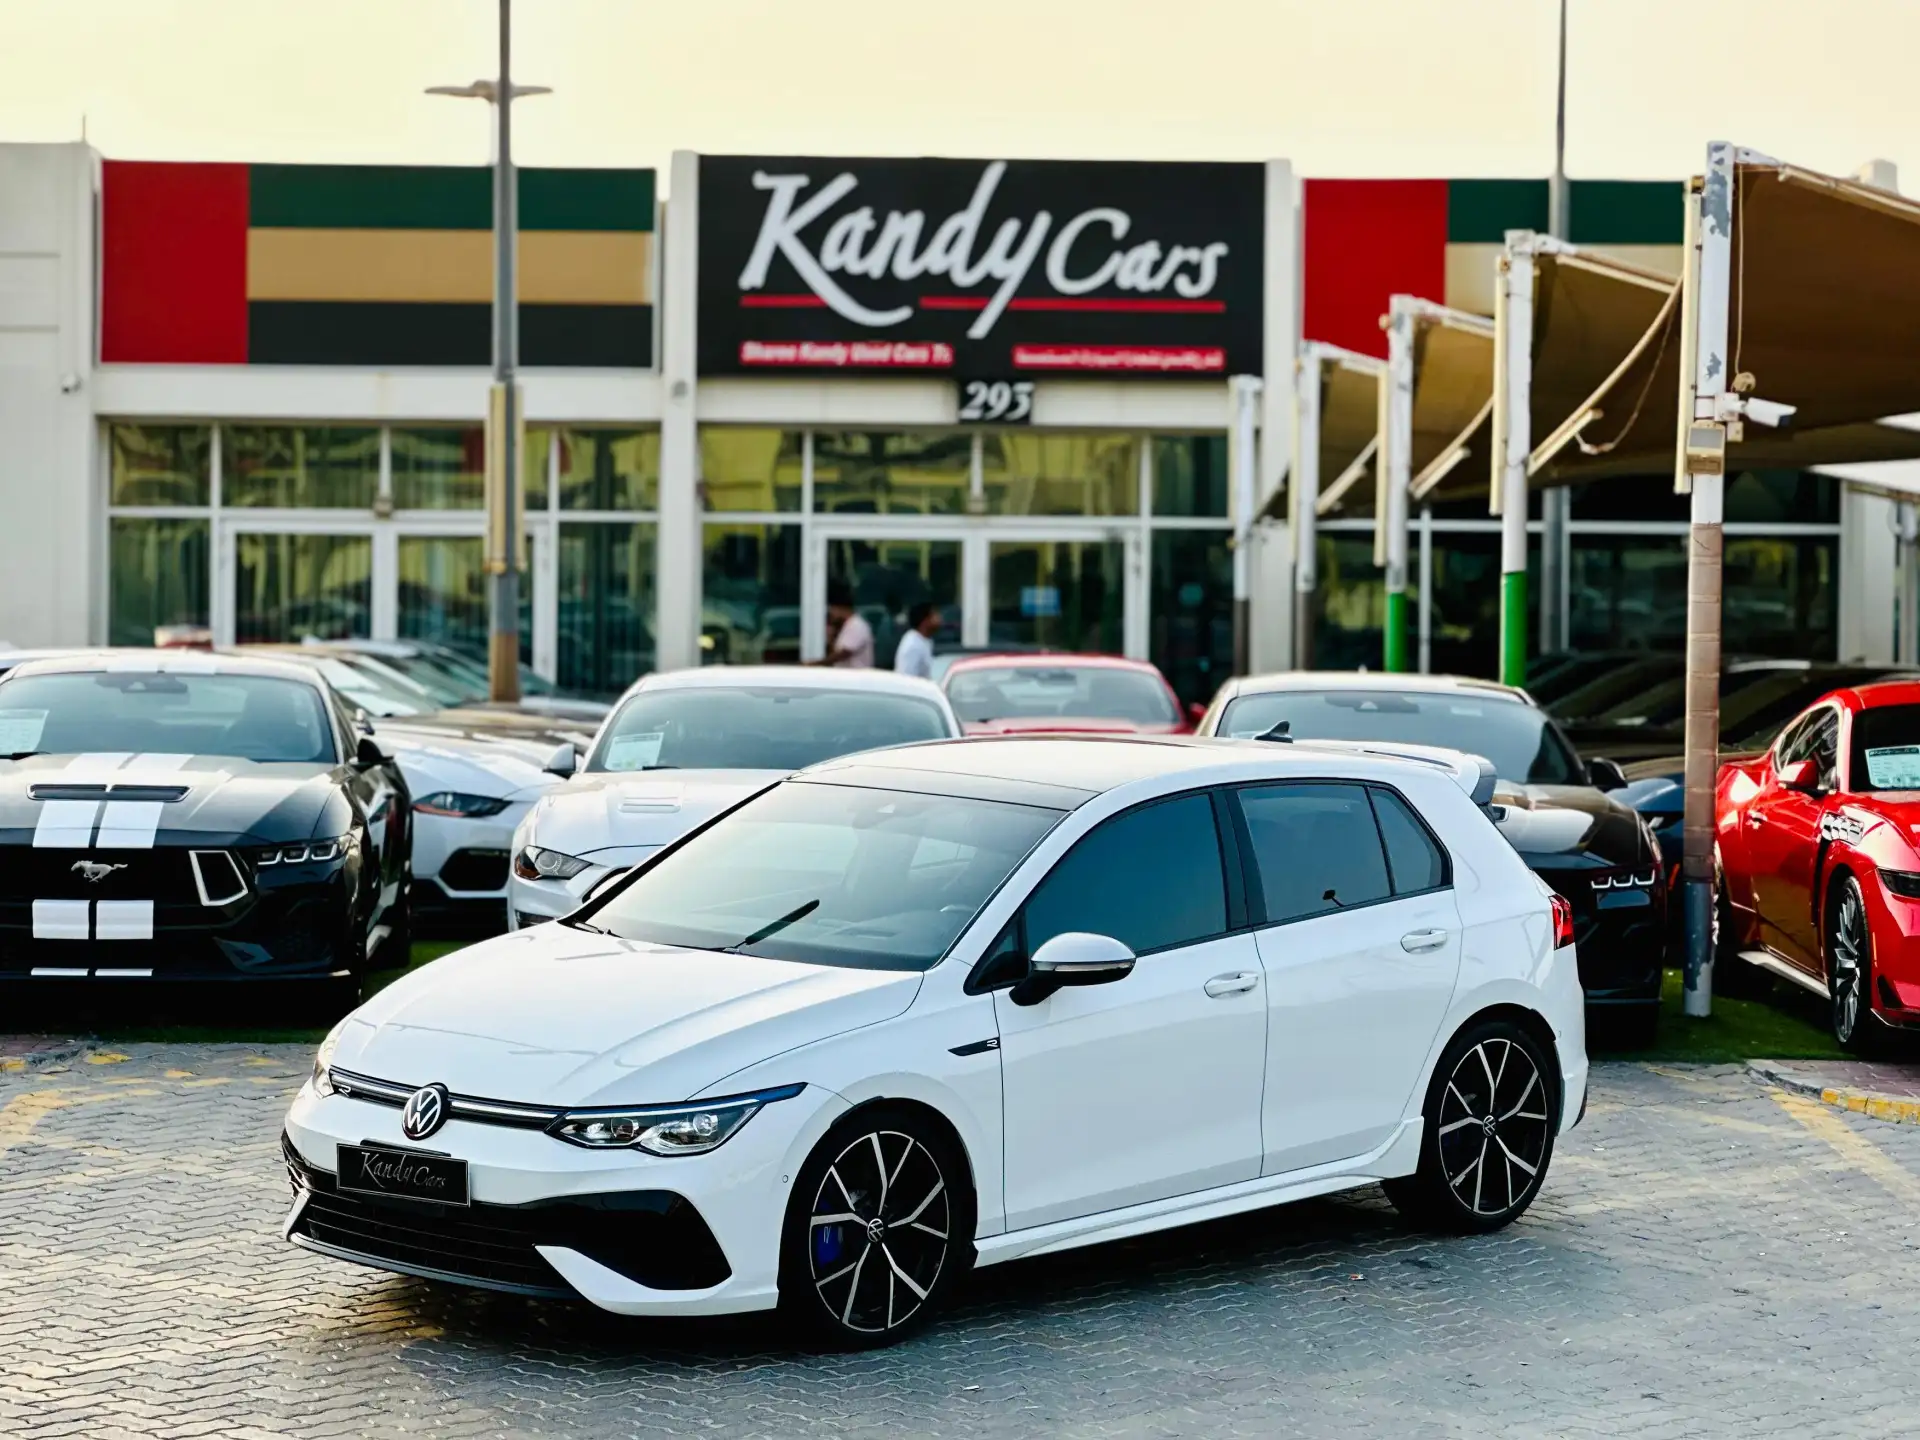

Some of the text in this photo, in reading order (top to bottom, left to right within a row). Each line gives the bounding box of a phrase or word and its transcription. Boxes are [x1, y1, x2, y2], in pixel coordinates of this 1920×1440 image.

[738, 160, 1228, 339] Kandy Cars
[360, 1152, 447, 1188] Kandy Cars
